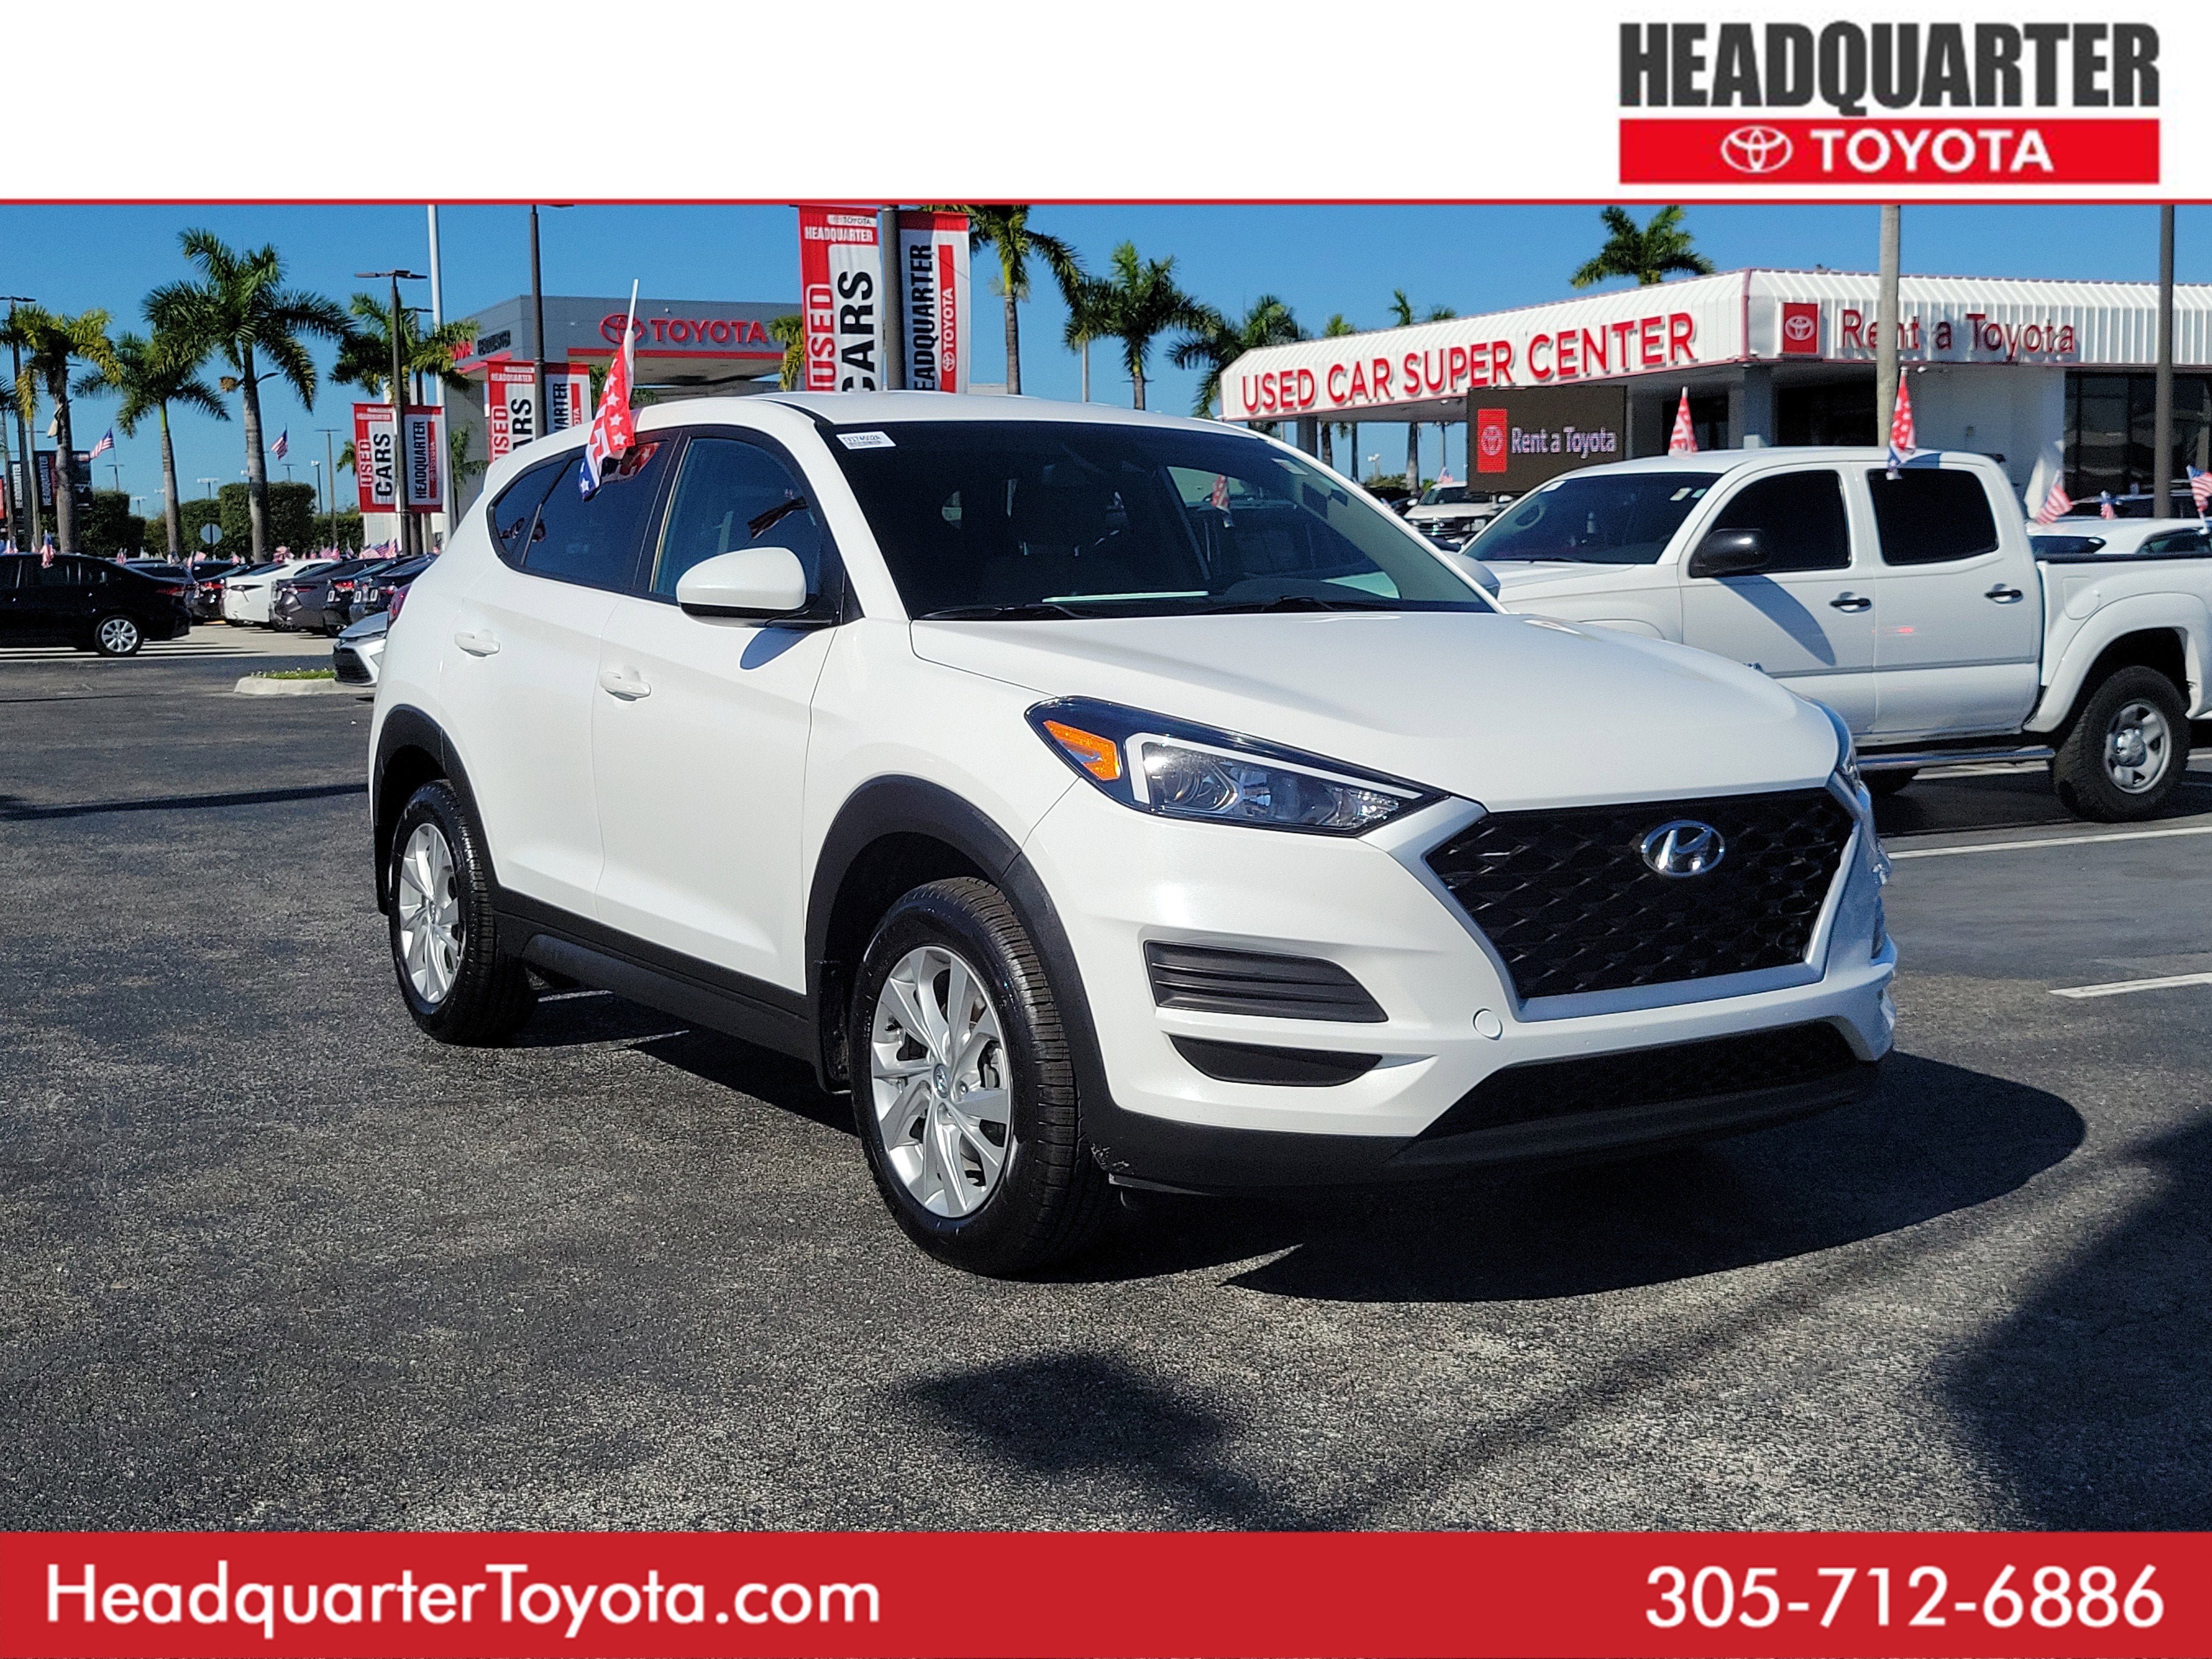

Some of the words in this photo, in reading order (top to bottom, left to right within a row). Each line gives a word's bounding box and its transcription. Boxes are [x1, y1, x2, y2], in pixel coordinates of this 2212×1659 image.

[804, 225, 873, 242] HEADQUARTER
[649, 318, 768, 343] TOYOTA
[808, 286, 836, 383] USED
[910, 244, 939, 391] EADQUARTER
[941, 287, 956, 350] TOYOTA
[1934, 321, 1952, 351] a
[1965, 313, 2076, 363] Toyota
[1242, 368, 1316, 413] USED
[1327, 357, 1392, 405] CAR
[1403, 340, 1514, 395] SUPER
[1527, 312, 1695, 381] CENTER
[360, 441, 373, 485] USED
[374, 433, 393, 496] CARS
[413, 421, 428, 499] HEADQUARTER
[1510, 426, 1548, 454] Rent
[1550, 432, 1561, 454] a
[1564, 426, 1617, 459] Toyota
